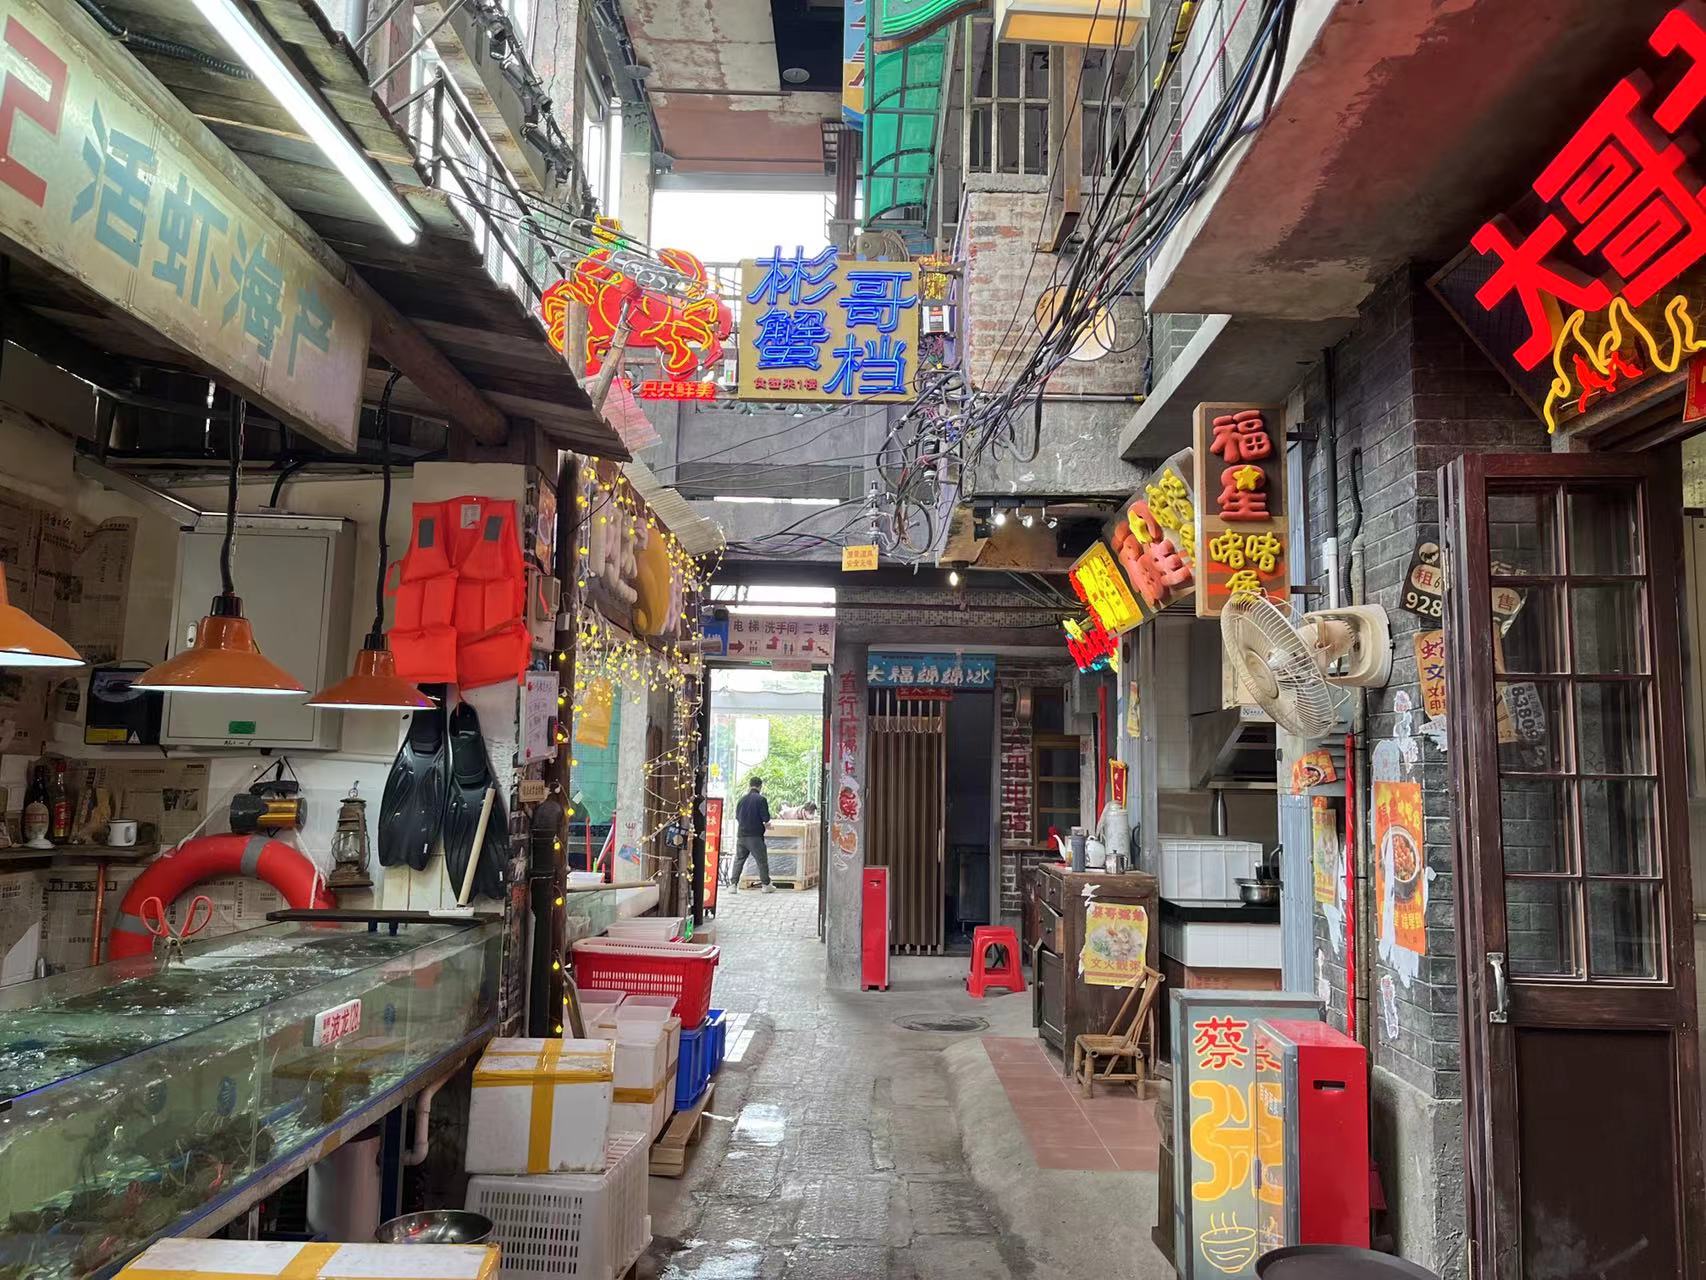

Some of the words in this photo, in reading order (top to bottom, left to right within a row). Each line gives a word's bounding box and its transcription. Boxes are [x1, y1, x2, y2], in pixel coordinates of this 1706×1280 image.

[748, 244, 917, 332] 彬哥
[752, 308, 909, 397] 蟹档
[640, 380, 716, 399] 只只鲜美
[1209, 409, 1273, 522] 福星
[1414, 569, 1432, 587] 租
[733, 620, 759, 632] 电梯
[765, 621, 798, 635] 洗手间
[803, 623, 830, 636] 二楼
[1194, 1016, 1248, 1070] 蔡
